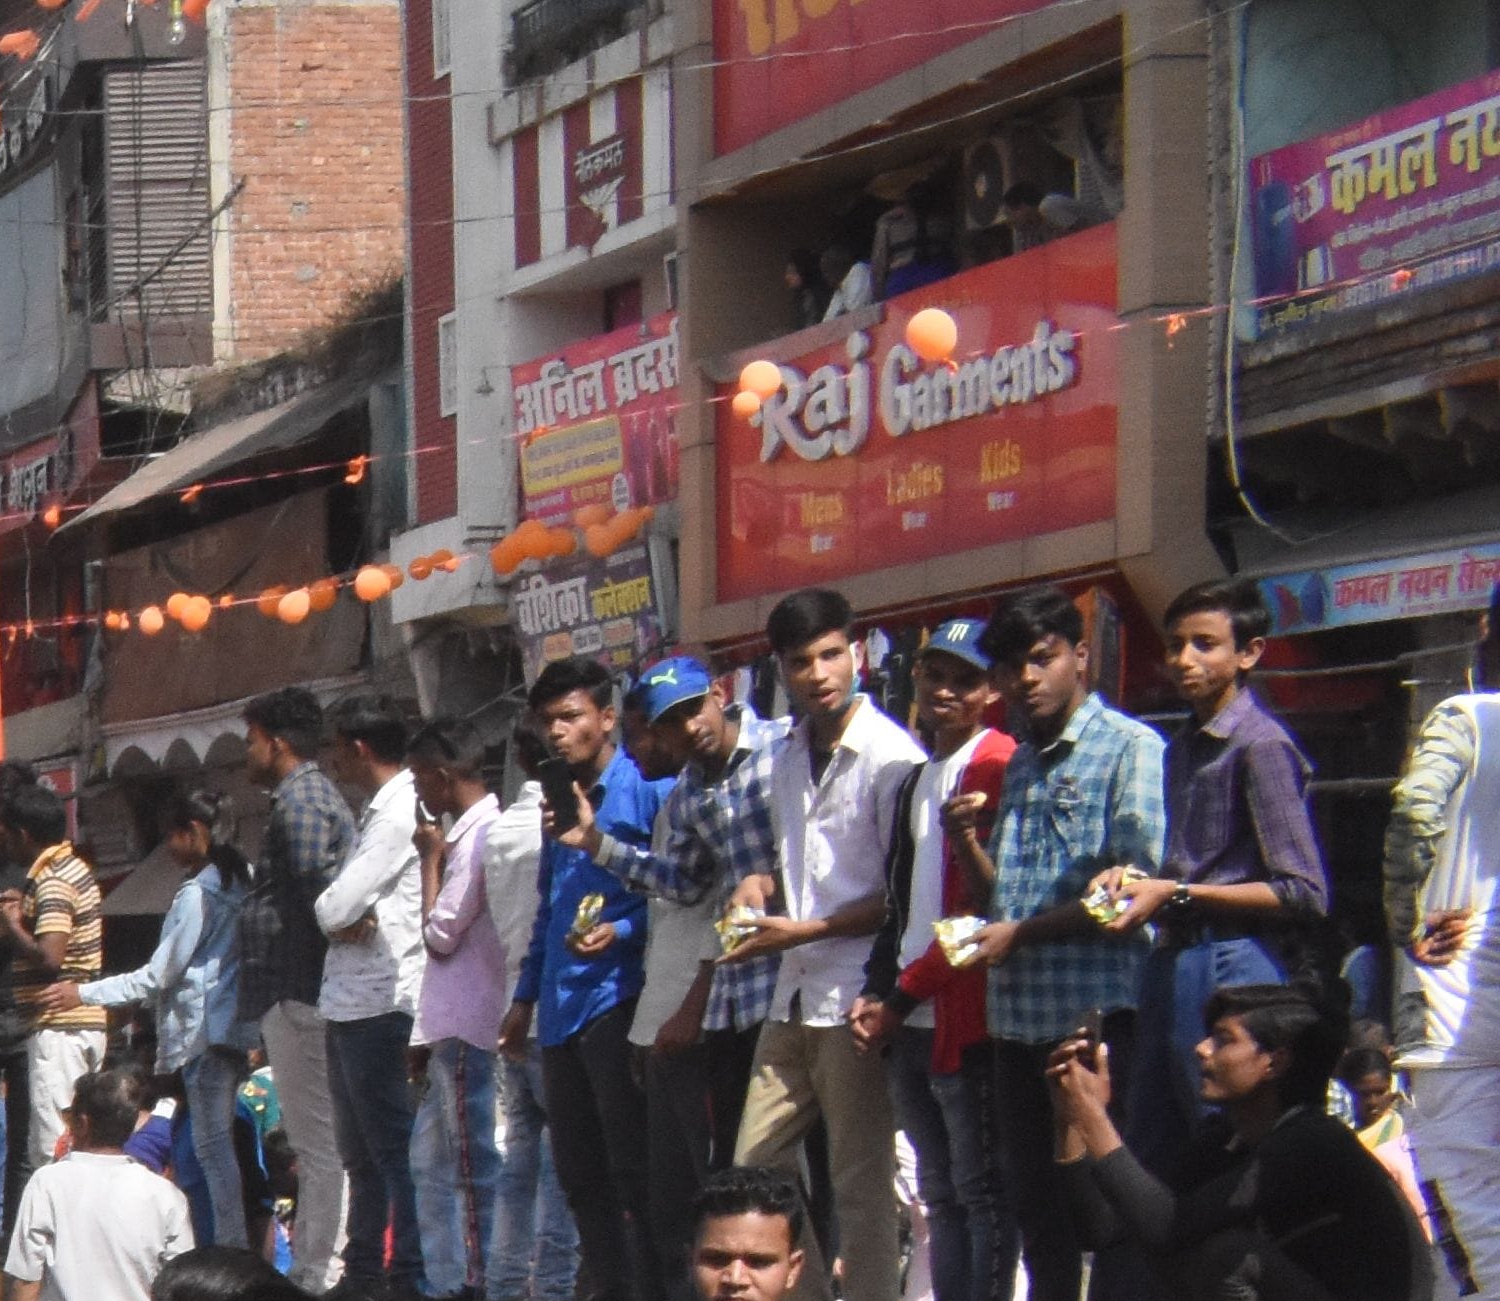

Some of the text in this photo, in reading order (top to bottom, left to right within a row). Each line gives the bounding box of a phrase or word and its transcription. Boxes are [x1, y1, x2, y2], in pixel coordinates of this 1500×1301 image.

[1326, 117, 1440, 214] कमल
[516, 359, 607, 434] अनिल
[748, 319, 1078, 462] Raj Garments
[887, 462, 945, 507] Ladies
[980, 440, 1022, 483] Kids
[801, 491, 846, 528] Mens
